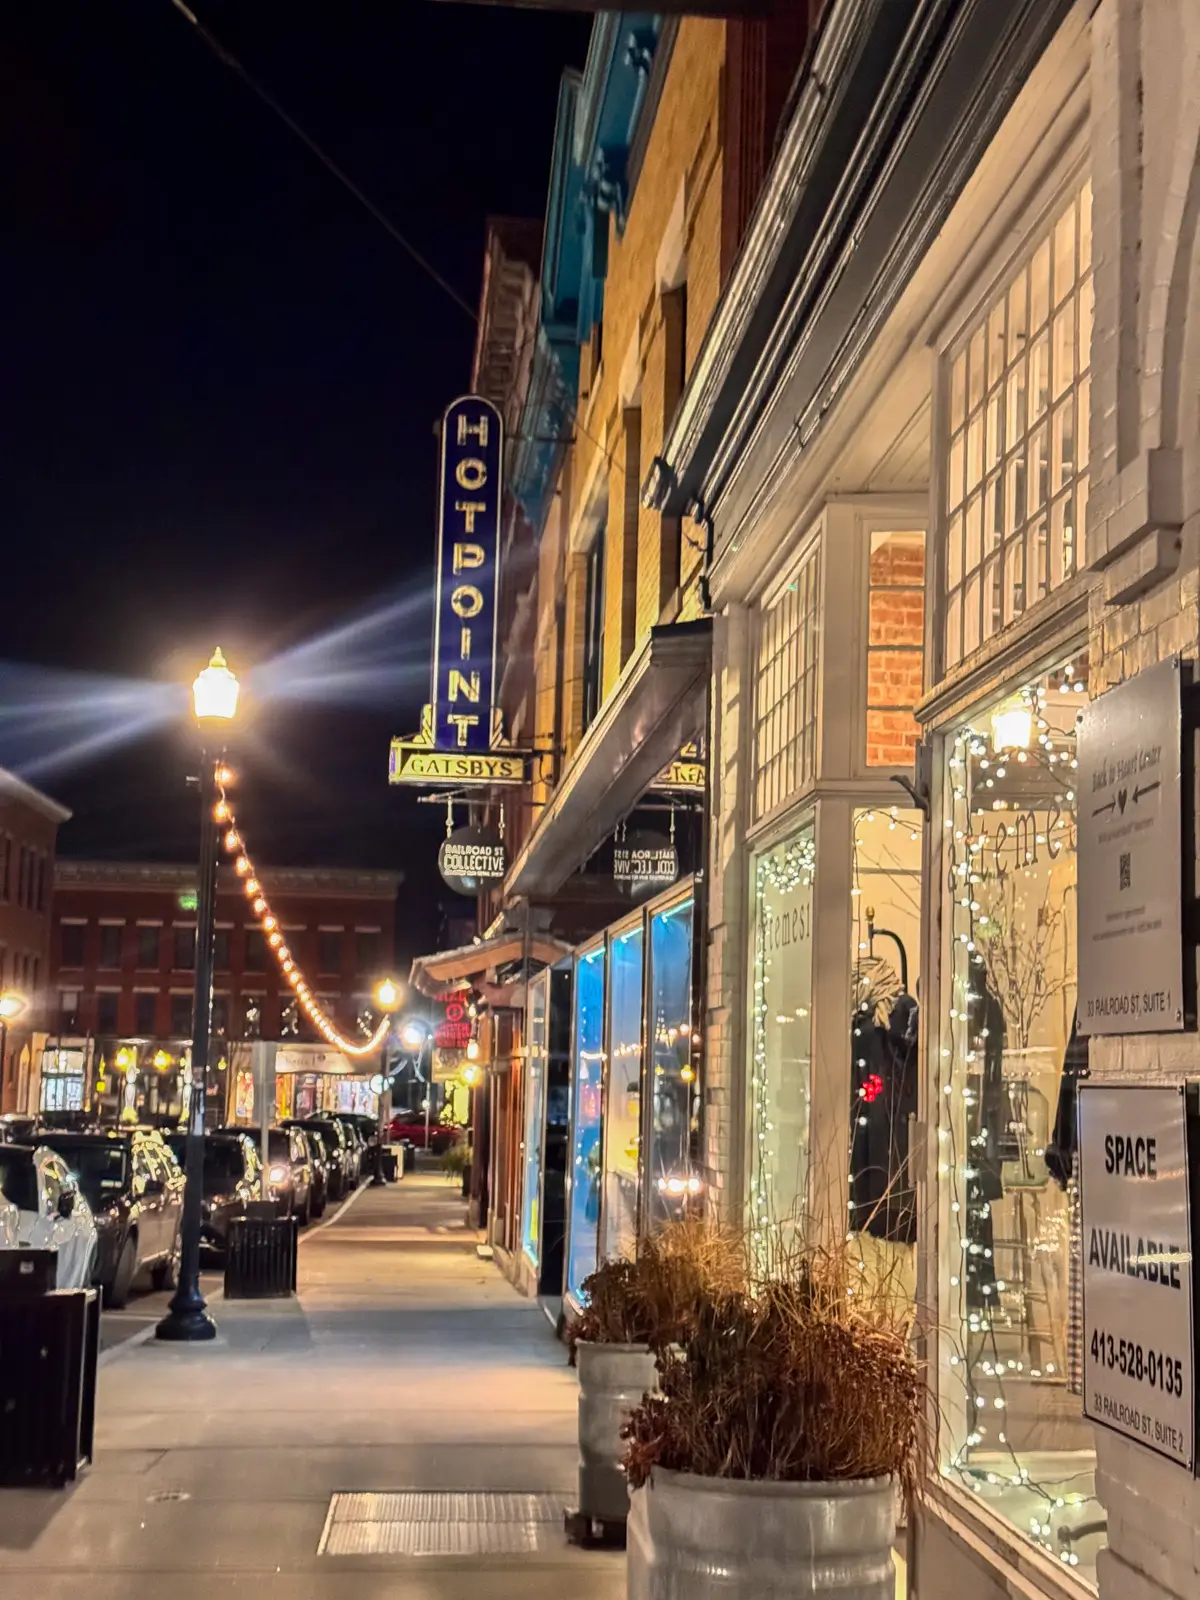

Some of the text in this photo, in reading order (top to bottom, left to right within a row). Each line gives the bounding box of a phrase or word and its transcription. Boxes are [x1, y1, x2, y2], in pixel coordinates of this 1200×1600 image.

[448, 414, 489, 747] HOTPOINT
[411, 758, 513, 777] GATSBYS
[444, 854, 504, 872] COLLECTIVE
[445, 844, 504, 856] RAILROAD ST
[1095, 996, 1130, 1018] RAILROAD
[1143, 991, 1165, 1013] SUITE
[1105, 1134, 1157, 1180] SPACE
[1089, 1227, 1181, 1290] AVAILABLE
[1091, 1328, 1183, 1399] 413-528-0135
[1094, 1392, 1102, 1413] 33
[1103, 1396, 1140, 1430] RAILROAD
[1155, 1420, 1177, 1451] SUITE
[1178, 1428, 1184, 1453] 2
